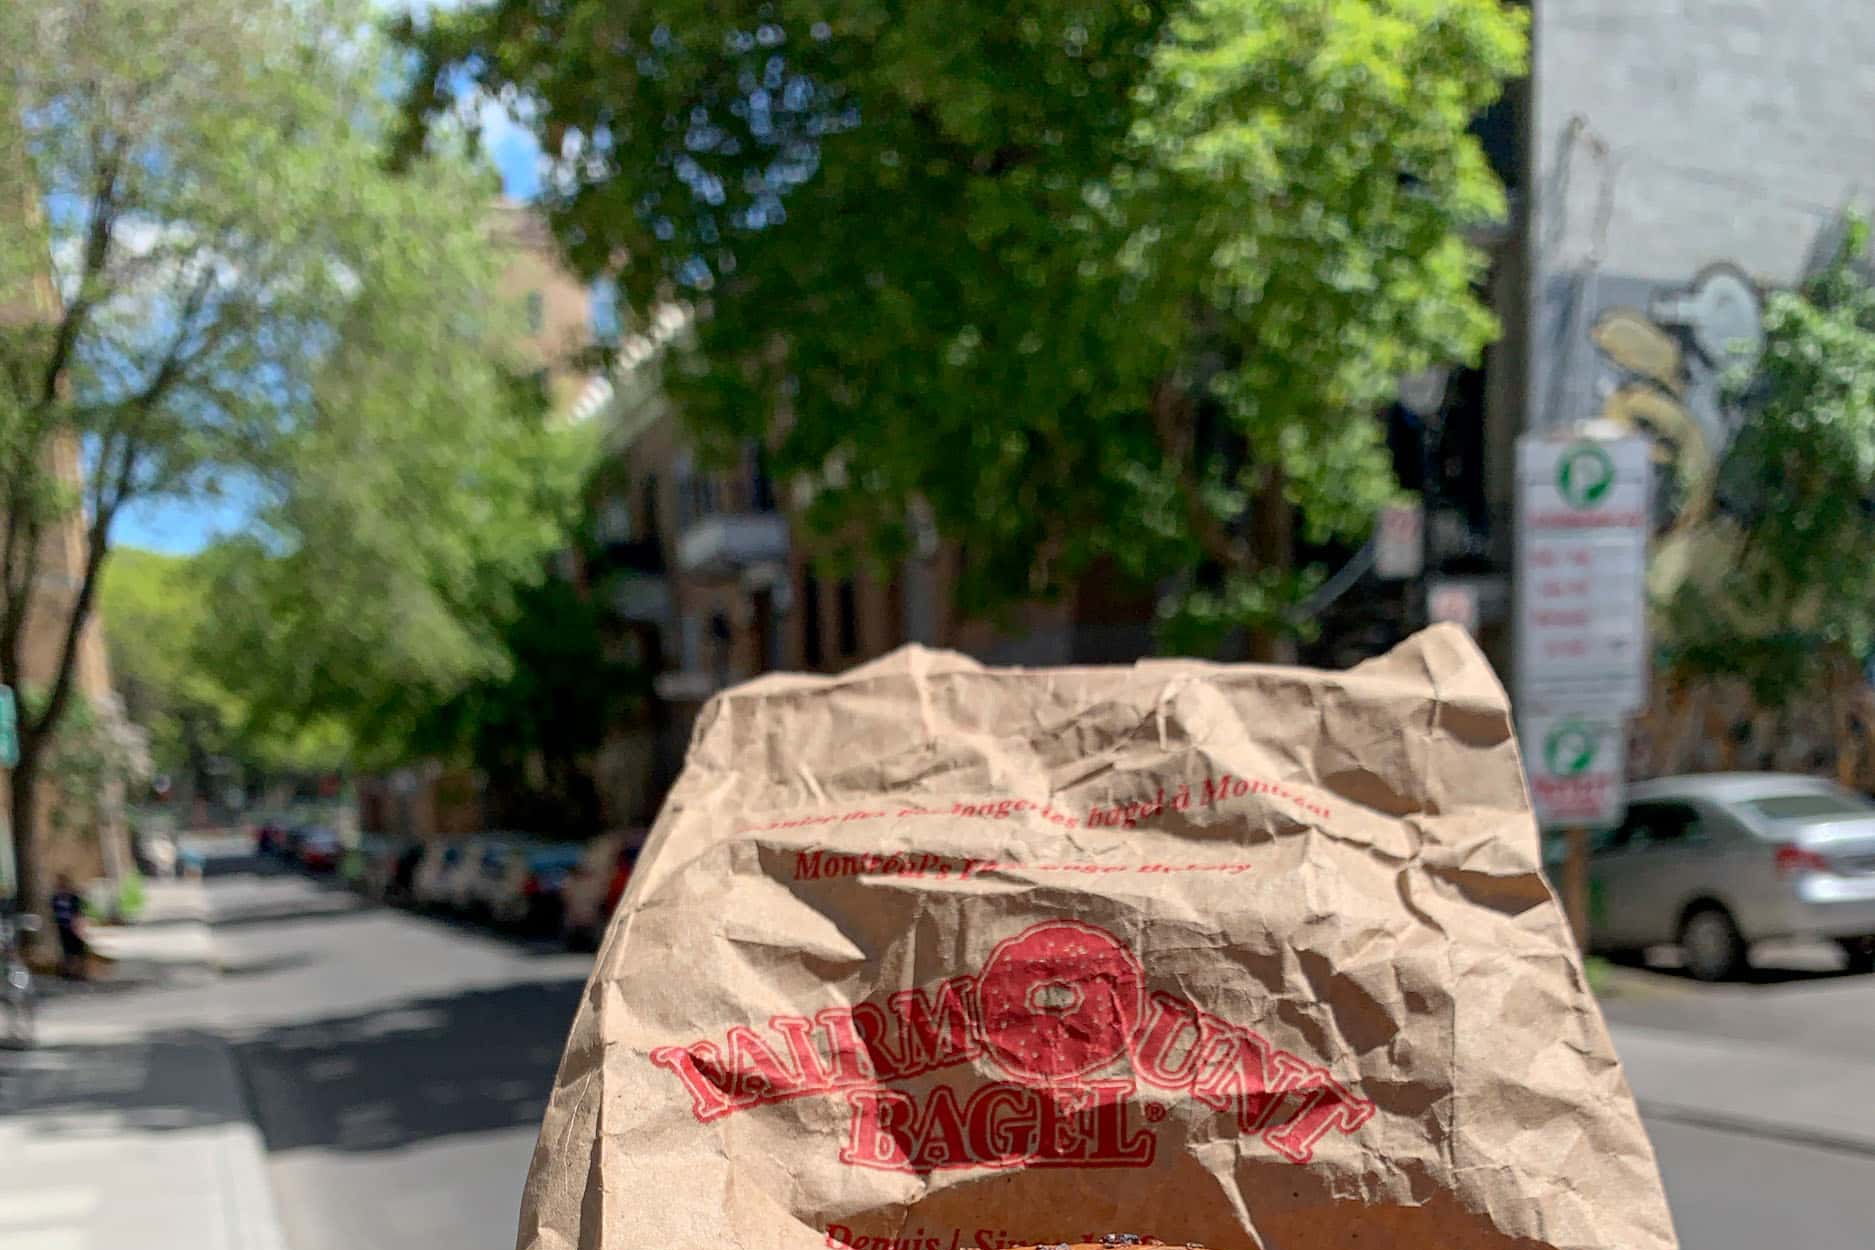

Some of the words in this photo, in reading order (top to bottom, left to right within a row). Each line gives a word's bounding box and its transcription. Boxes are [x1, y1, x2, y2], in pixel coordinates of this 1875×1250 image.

[1087, 786, 1165, 831] bagel
[1172, 782, 1191, 811] à
[793, 848, 952, 881] Montréal's
[650, 918, 1376, 1164] FAIRMOUNT
